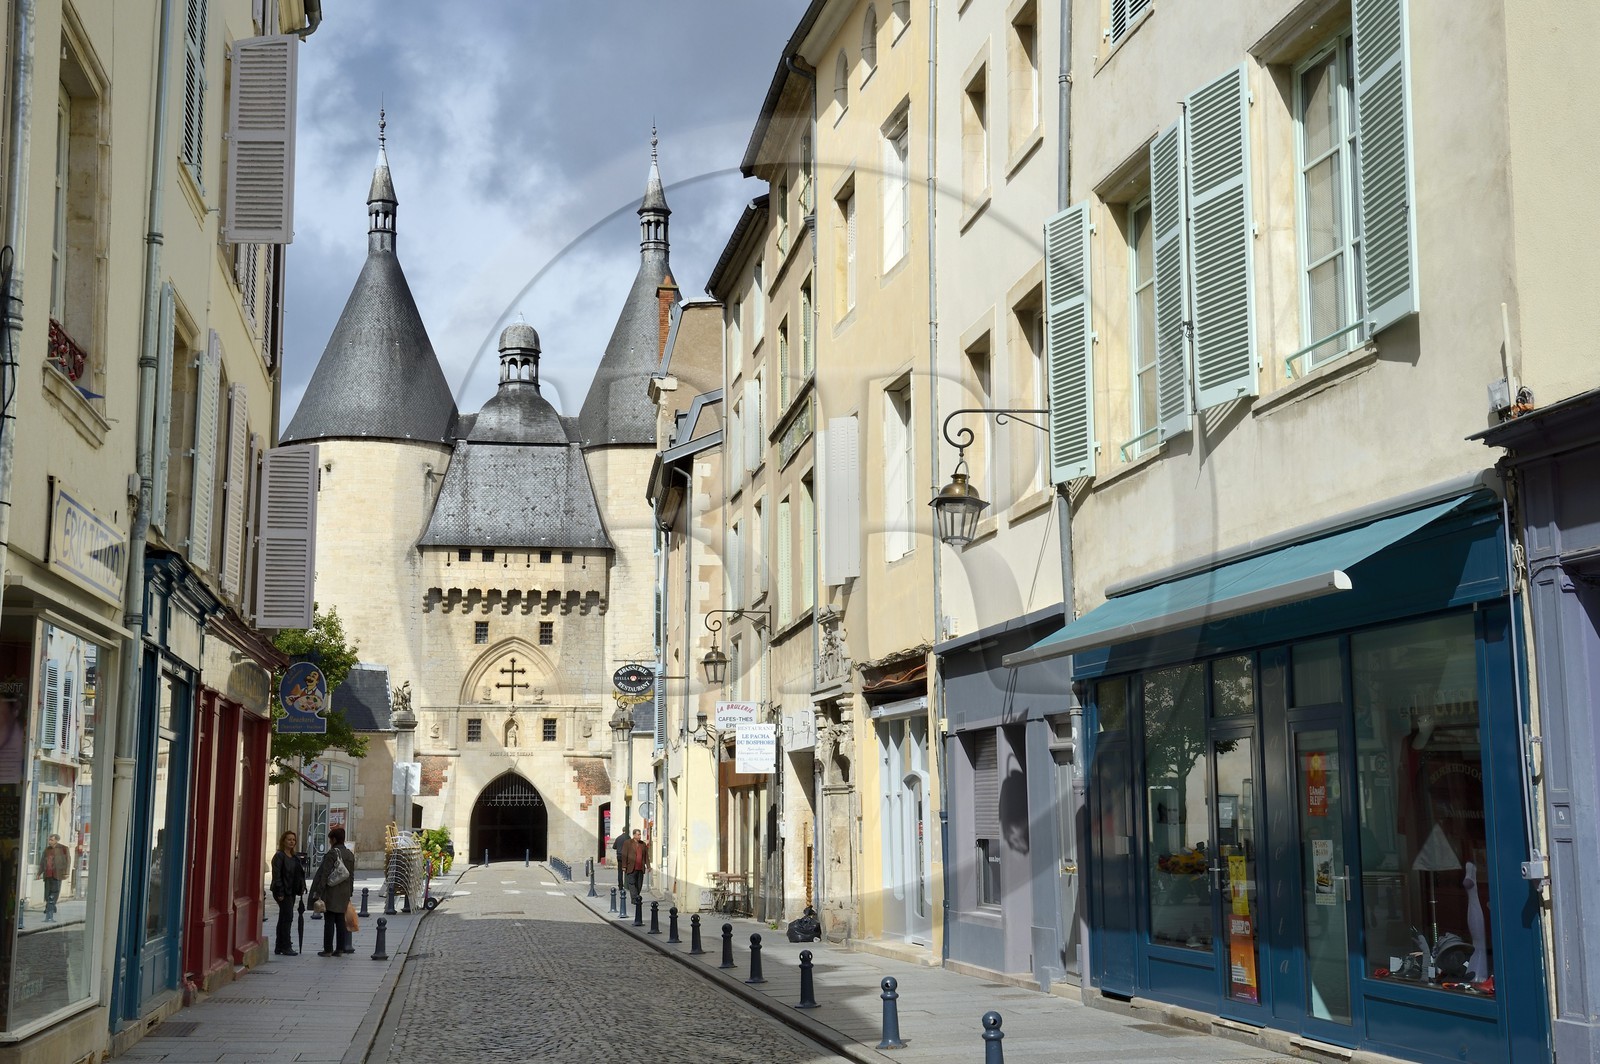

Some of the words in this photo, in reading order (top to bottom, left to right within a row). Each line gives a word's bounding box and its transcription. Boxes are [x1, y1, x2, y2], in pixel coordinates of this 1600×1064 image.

[62, 506, 88, 569] ERIC
[89, 523, 119, 588] TATTOO
[618, 665, 649, 676] BRASSERIE
[617, 681, 650, 692] RESTAURANT
[717, 705, 724, 714] LA
[726, 703, 755, 714] BRULERIE
